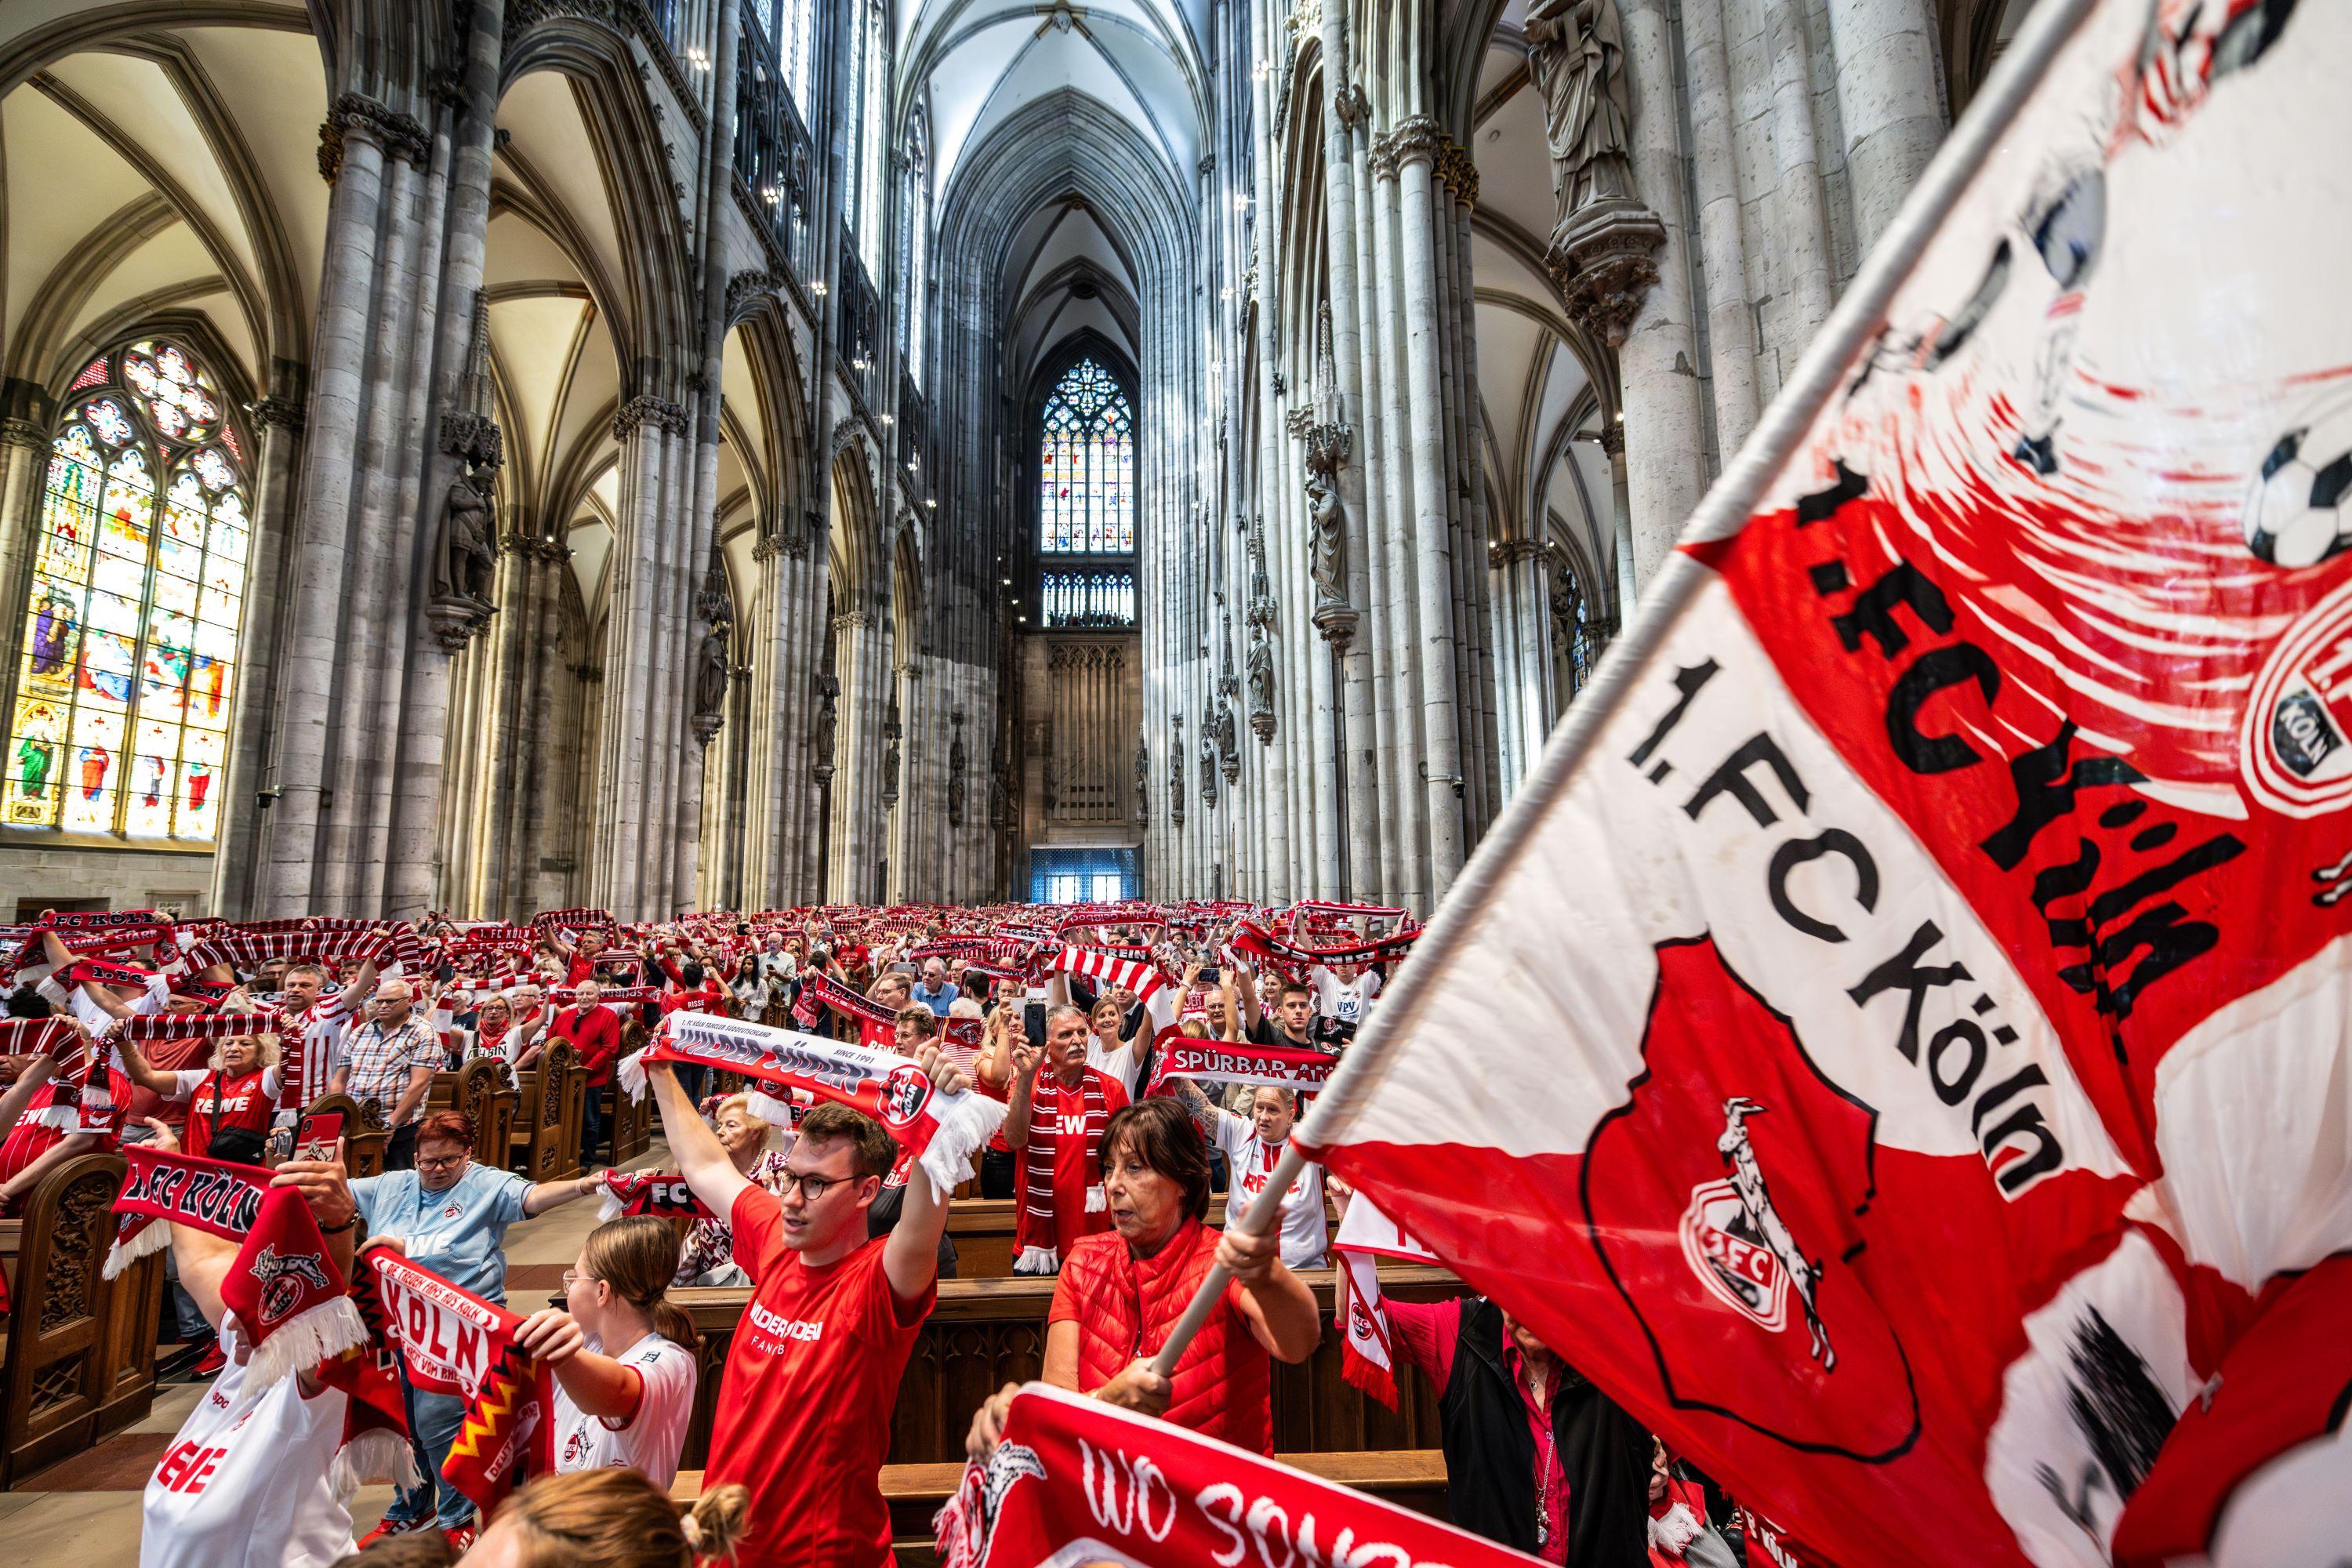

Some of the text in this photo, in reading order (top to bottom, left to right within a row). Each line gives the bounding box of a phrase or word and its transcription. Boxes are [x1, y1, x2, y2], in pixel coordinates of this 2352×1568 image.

[53, 914, 83, 927] FC
[492, 929, 502, 938] FC
[506, 927, 530, 938] KÖLN
[497, 941, 530, 952] KÖLN
[93, 965, 114, 979] 1.
[1681, 731, 1879, 944] FC
[1844, 918, 2065, 1195] Köln
[688, 999, 705, 1009] RISSE
[1337, 1000, 1356, 1013] VPV
[725, 1025, 772, 1038] SÜDDEUTSCHLAND
[833, 1048, 875, 1065] SINCE 1991
[1174, 1047, 1287, 1080] SPÜRBAR
[761, 1040, 873, 1096] SÜDEN
[1055, 1114, 1087, 1135] EW
[651, 1182, 688, 1204] FC
[1242, 1171, 1301, 1195] REE
[179, 1166, 265, 1236] KÖLN
[386, 1263, 398, 1277] DIE
[423, 1282, 446, 1298] FANS
[441, 1292, 461, 1306] AUS
[385, 1277, 481, 1379] KÖLN
[1076, 1436, 1177, 1543] WO
